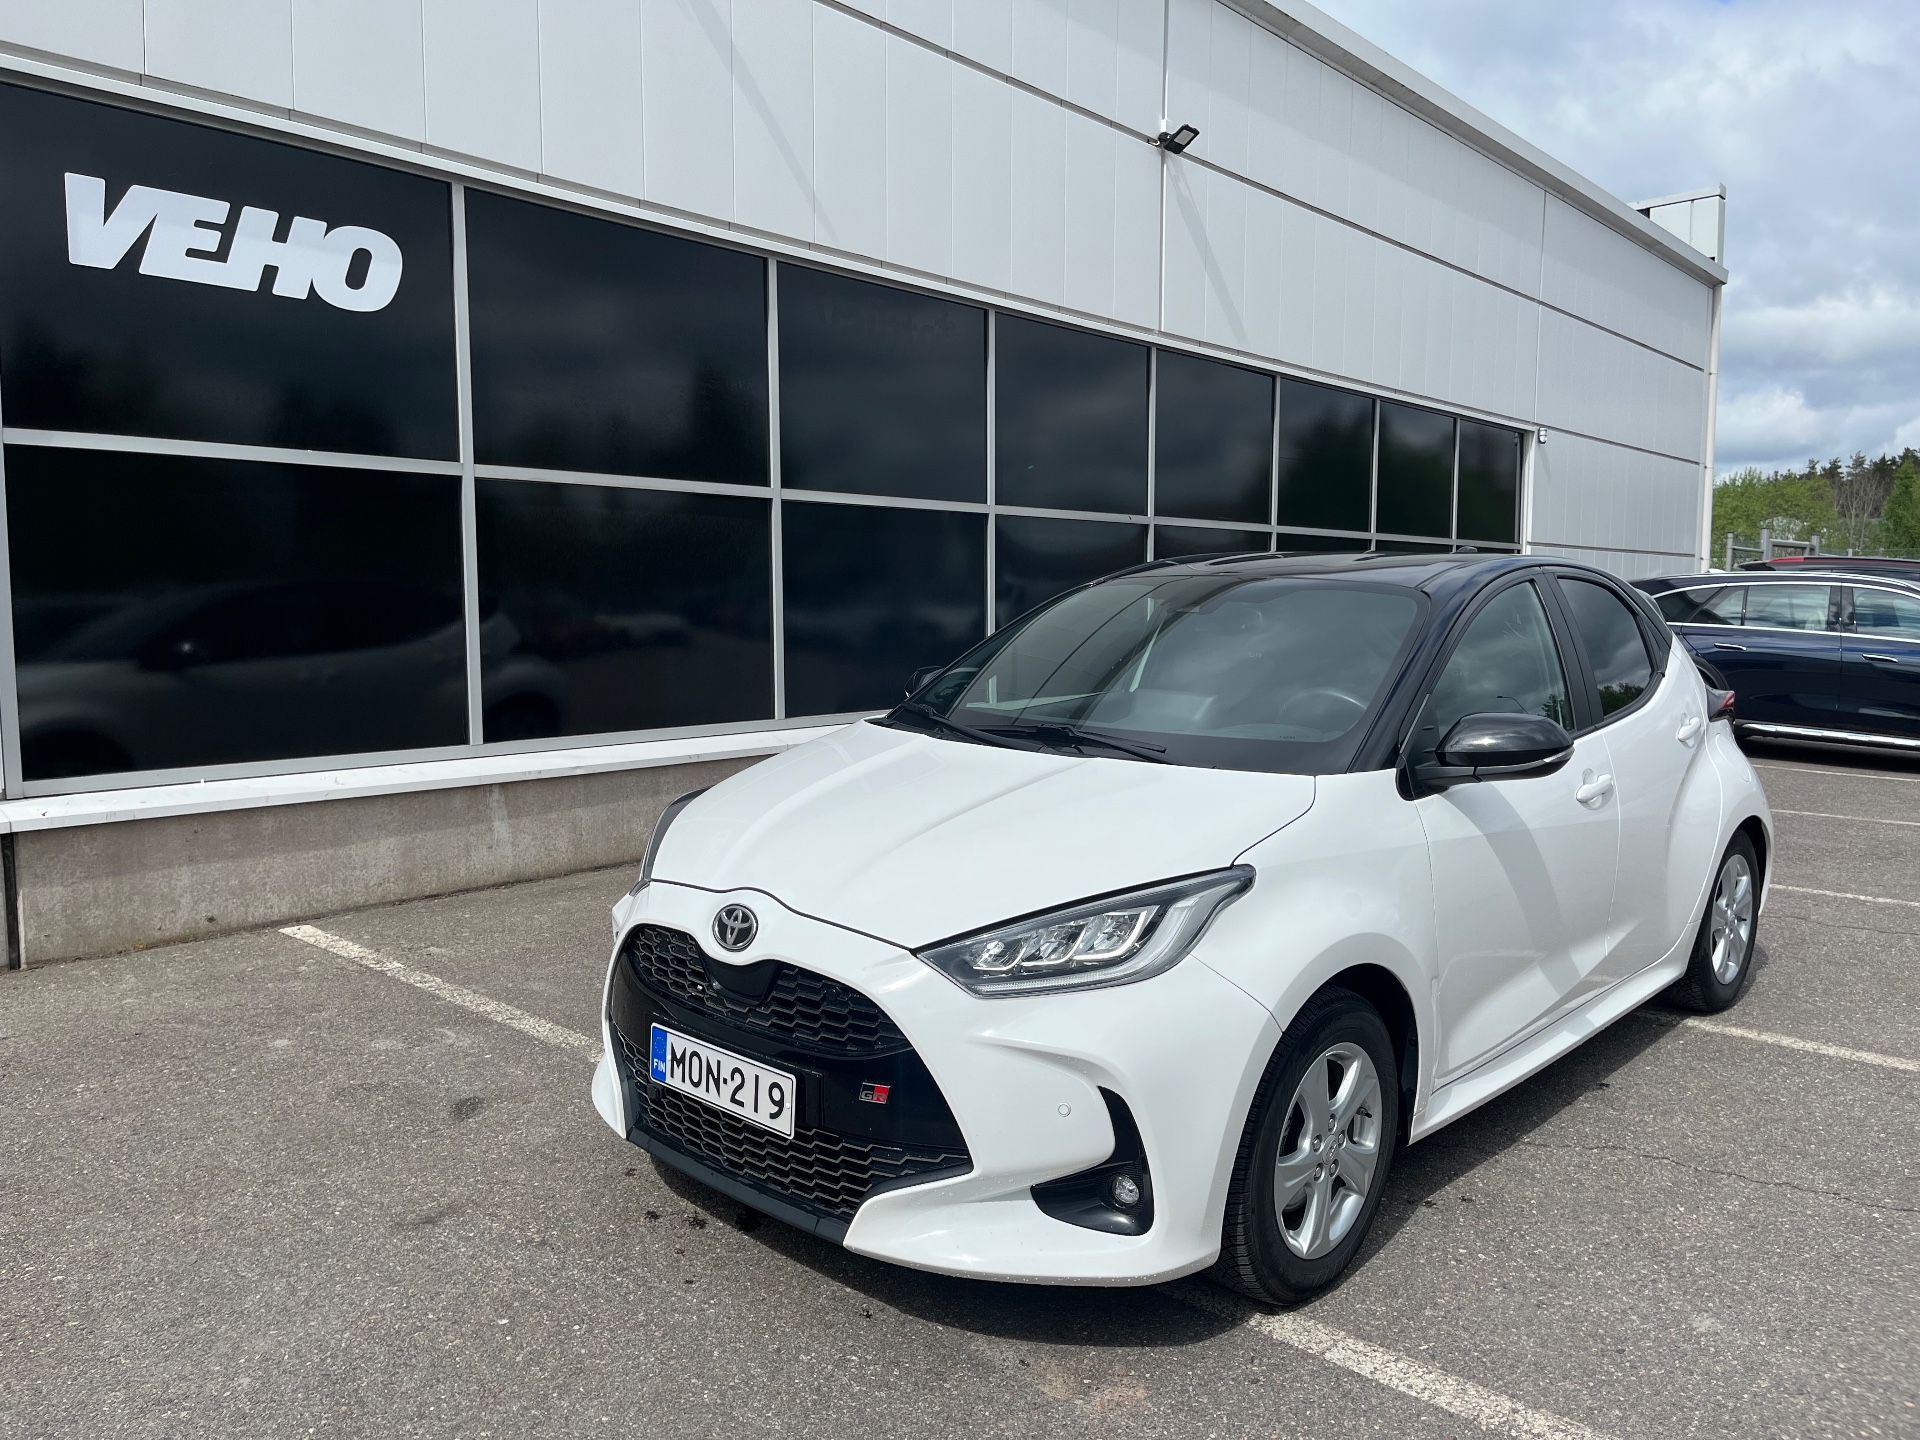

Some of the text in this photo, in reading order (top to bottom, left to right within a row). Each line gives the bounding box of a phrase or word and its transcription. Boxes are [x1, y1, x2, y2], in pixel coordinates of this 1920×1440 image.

[65, 172, 403, 312] VEHO
[653, 1058, 666, 1073] FIN
[670, 1042, 785, 1120] MON-219
[860, 1089, 887, 1103] GR
